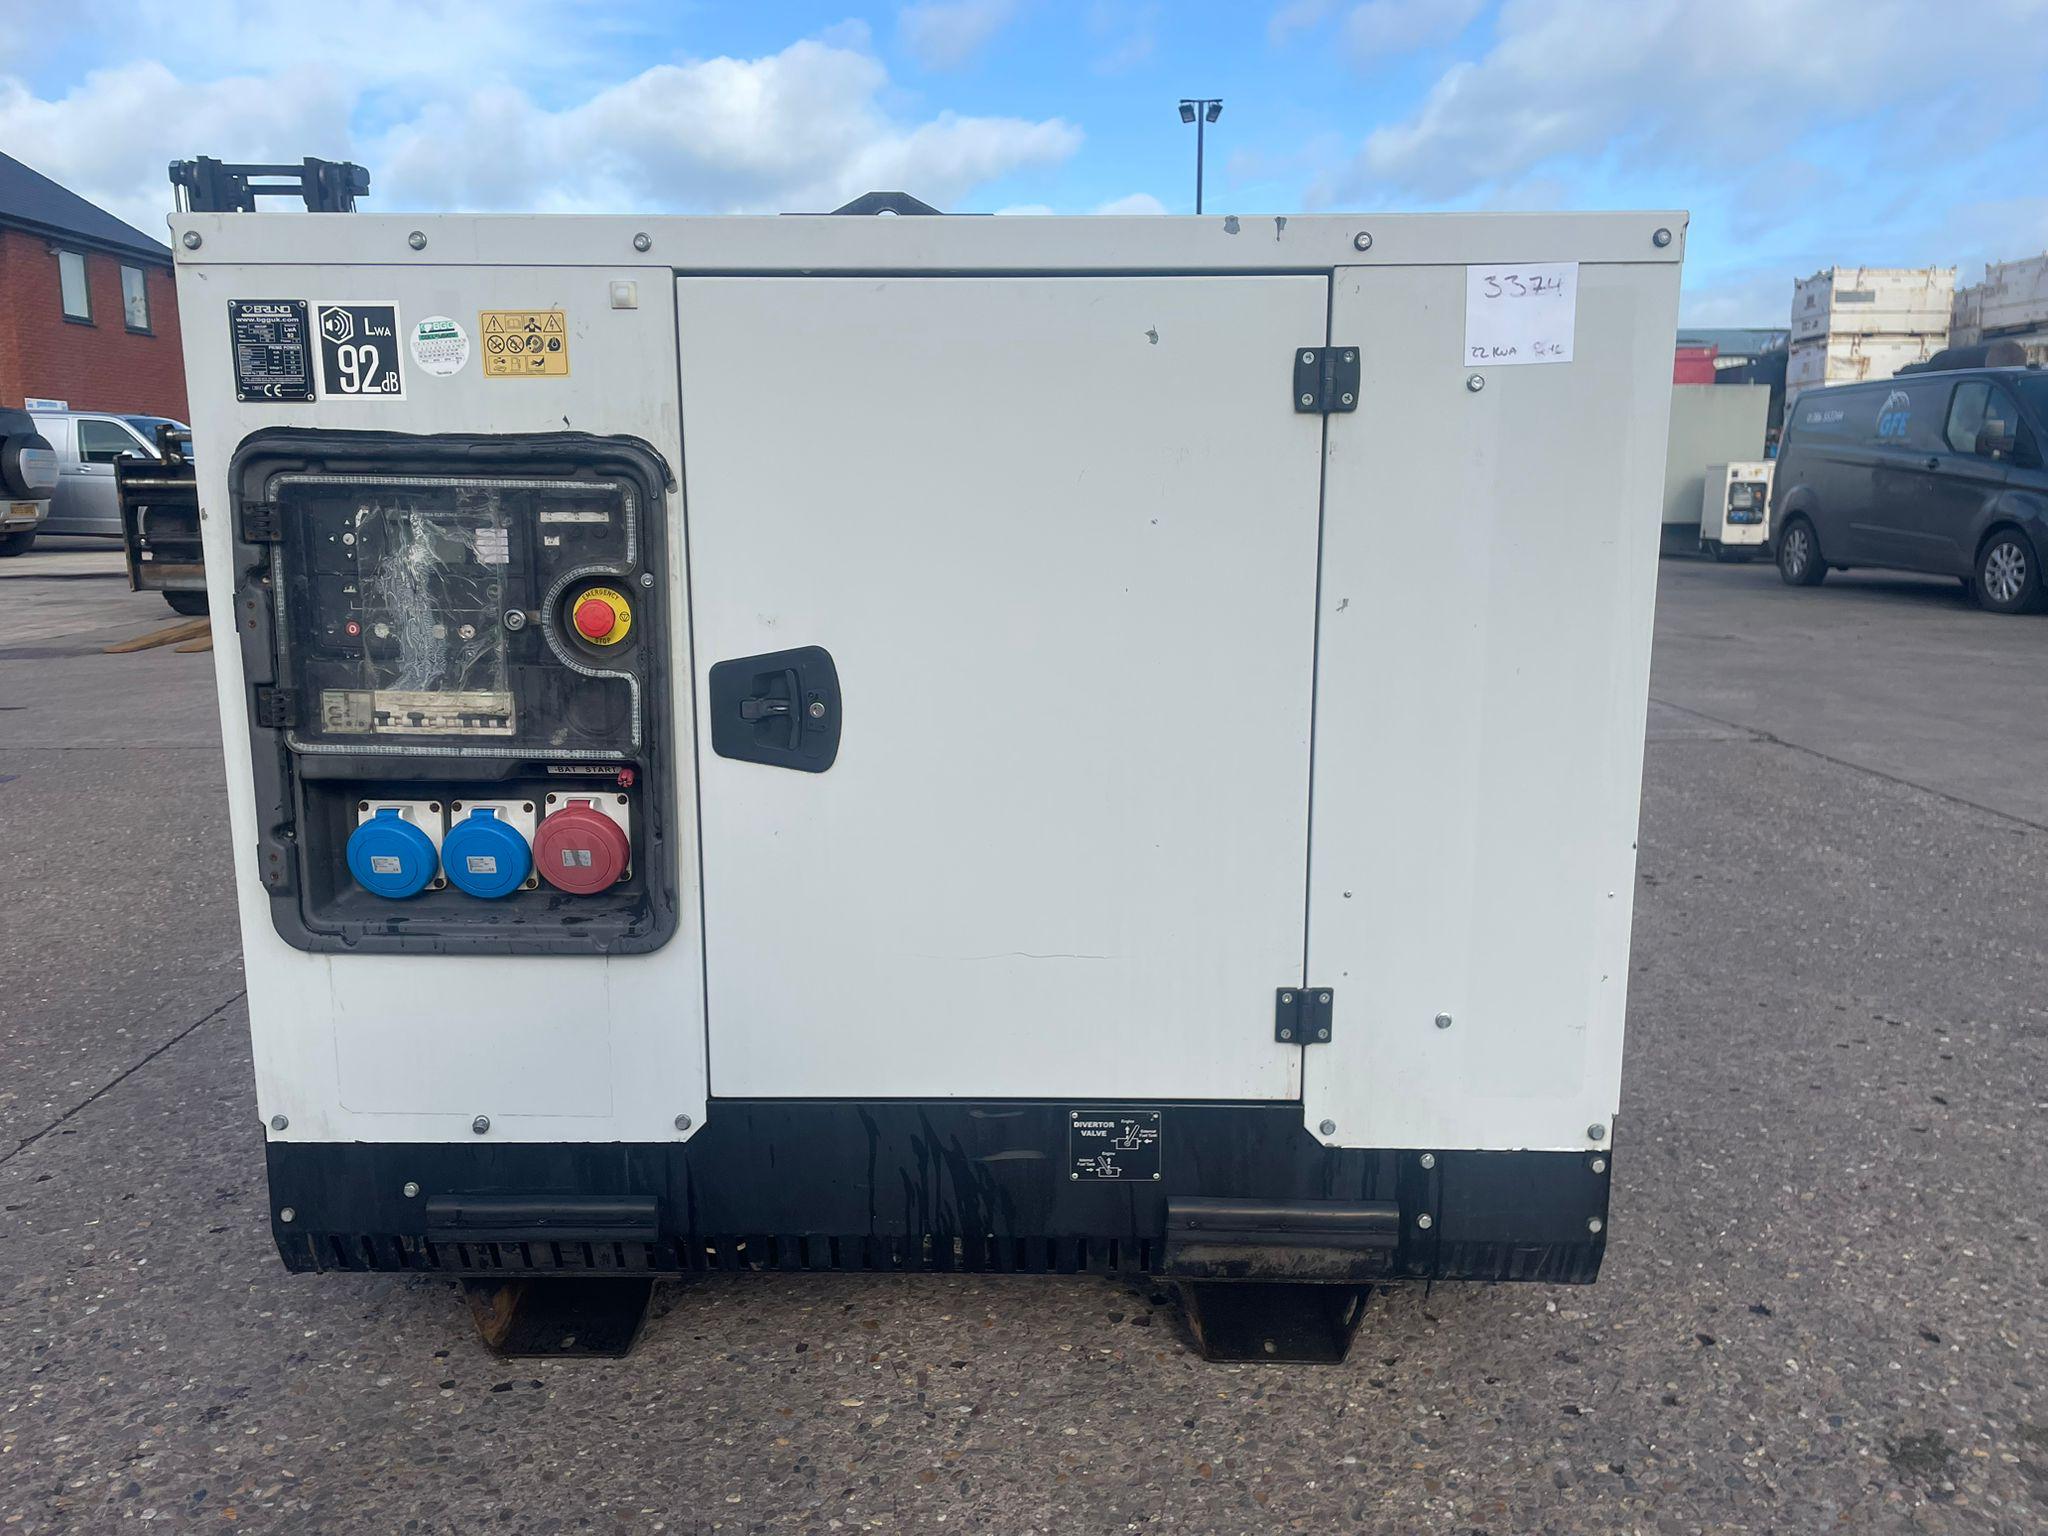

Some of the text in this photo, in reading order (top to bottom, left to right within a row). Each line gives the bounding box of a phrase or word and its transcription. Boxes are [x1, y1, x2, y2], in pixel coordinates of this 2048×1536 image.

[1484, 274, 1562, 298] 3374
[254, 305, 291, 313] BRUNO
[337, 344, 382, 393] 92
[381, 371, 399, 392] dB
[582, 588, 619, 600] EMERGENCY
[594, 637, 611, 645] STOP
